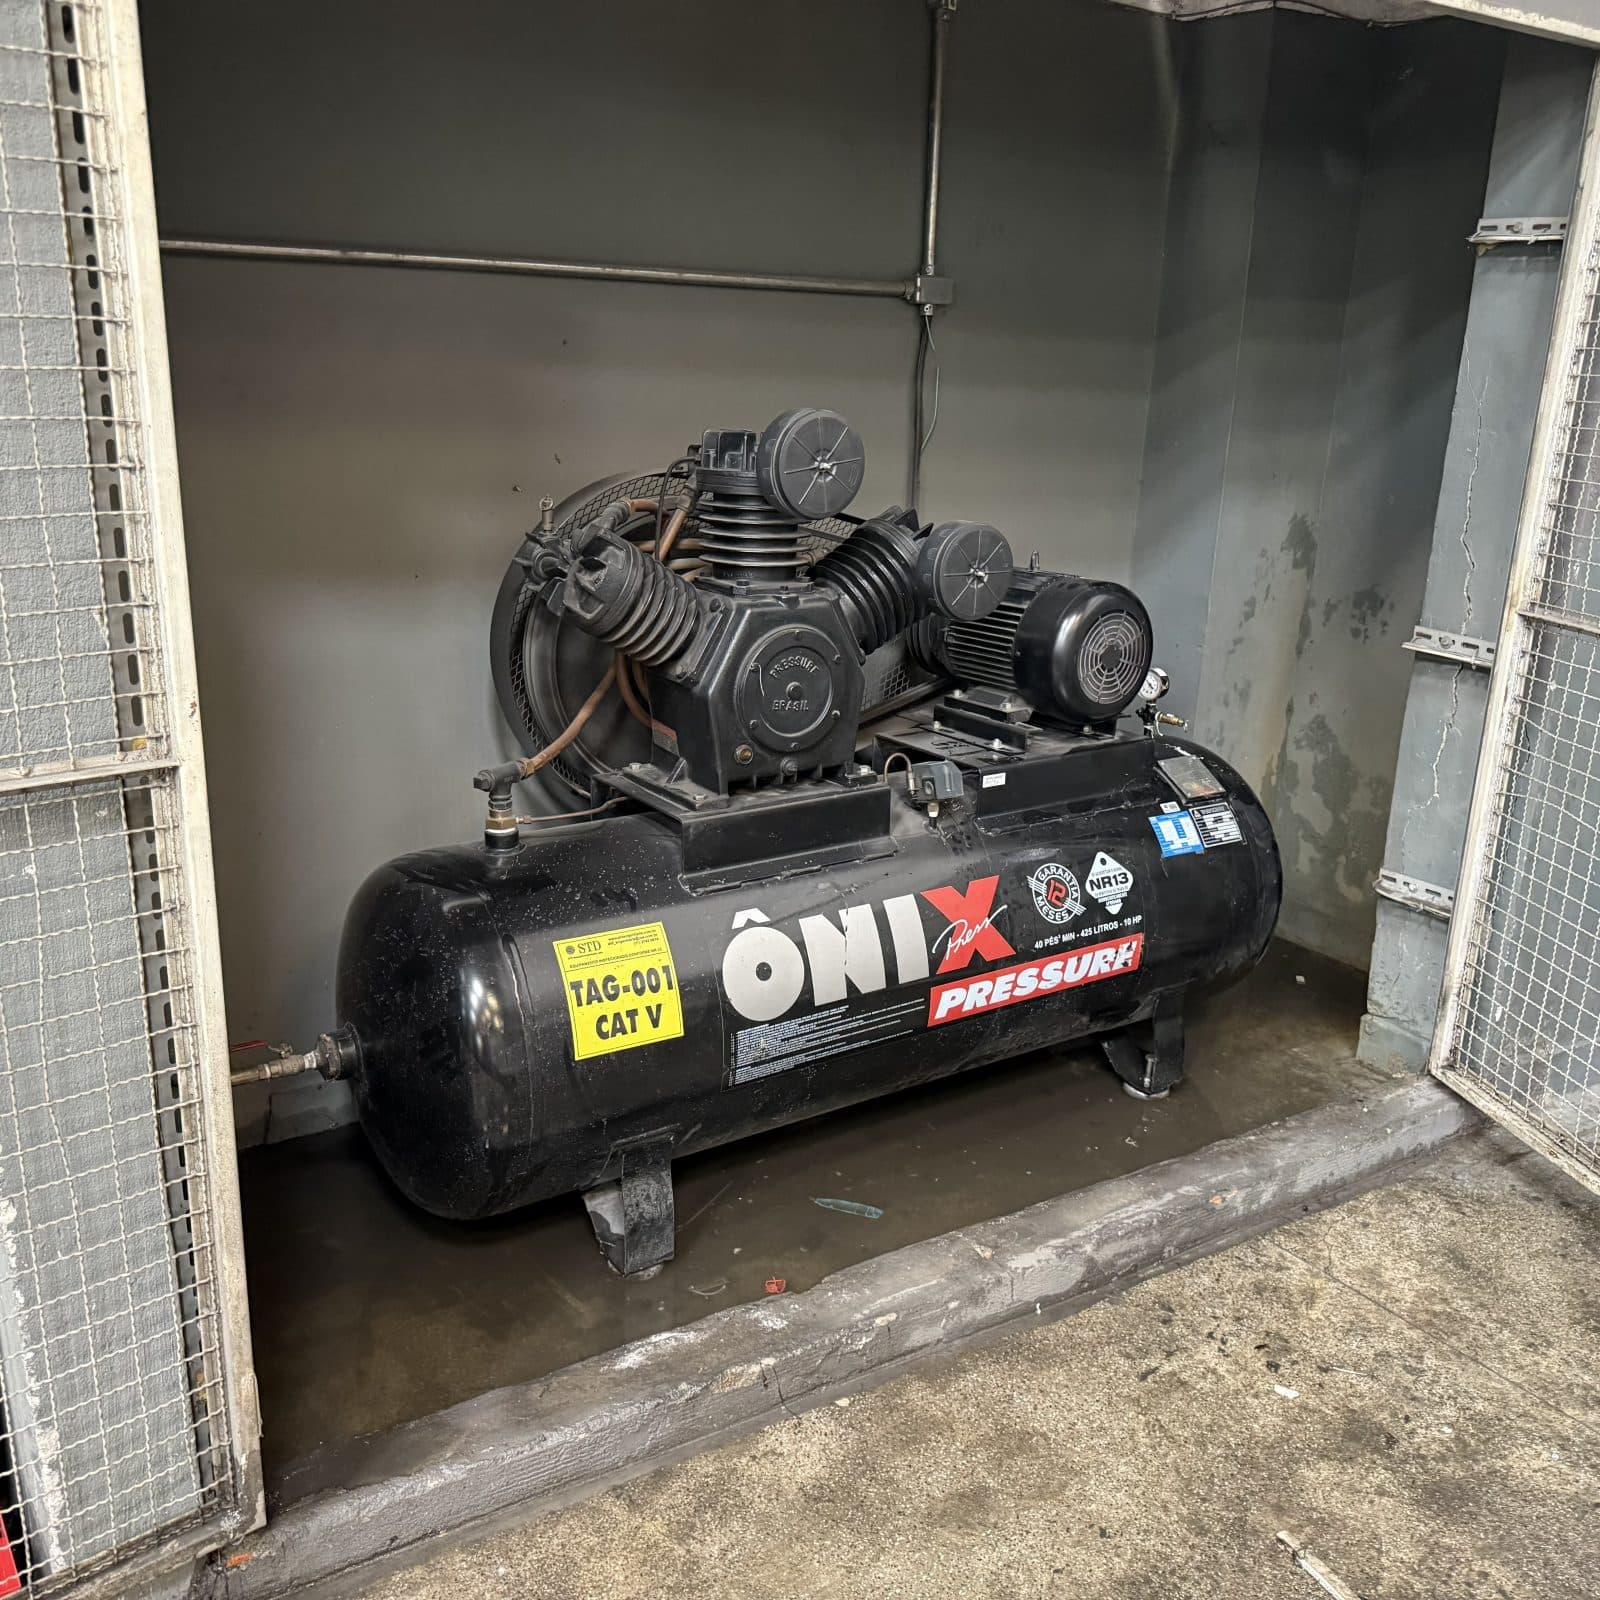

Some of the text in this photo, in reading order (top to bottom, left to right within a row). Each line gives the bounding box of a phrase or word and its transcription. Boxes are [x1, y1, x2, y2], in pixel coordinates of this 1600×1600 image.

[772, 700, 809, 711] BRASIL
[1038, 866, 1079, 899] GARANTIA
[1047, 879, 1067, 907] 12
[1089, 872, 1129, 891] NR13
[1036, 895, 1069, 921] MESES
[1034, 940, 1043, 949] 40
[1062, 931, 1076, 942] MIN
[1080, 927, 1093, 937] 425
[1093, 920, 1119, 934] LITROS
[1124, 917, 1132, 926] 10
[1132, 914, 1143, 924] HP
[577, 940, 602, 954] STD
[569, 965, 674, 1007] TAG-001
[595, 1003, 663, 1040] CAT V
